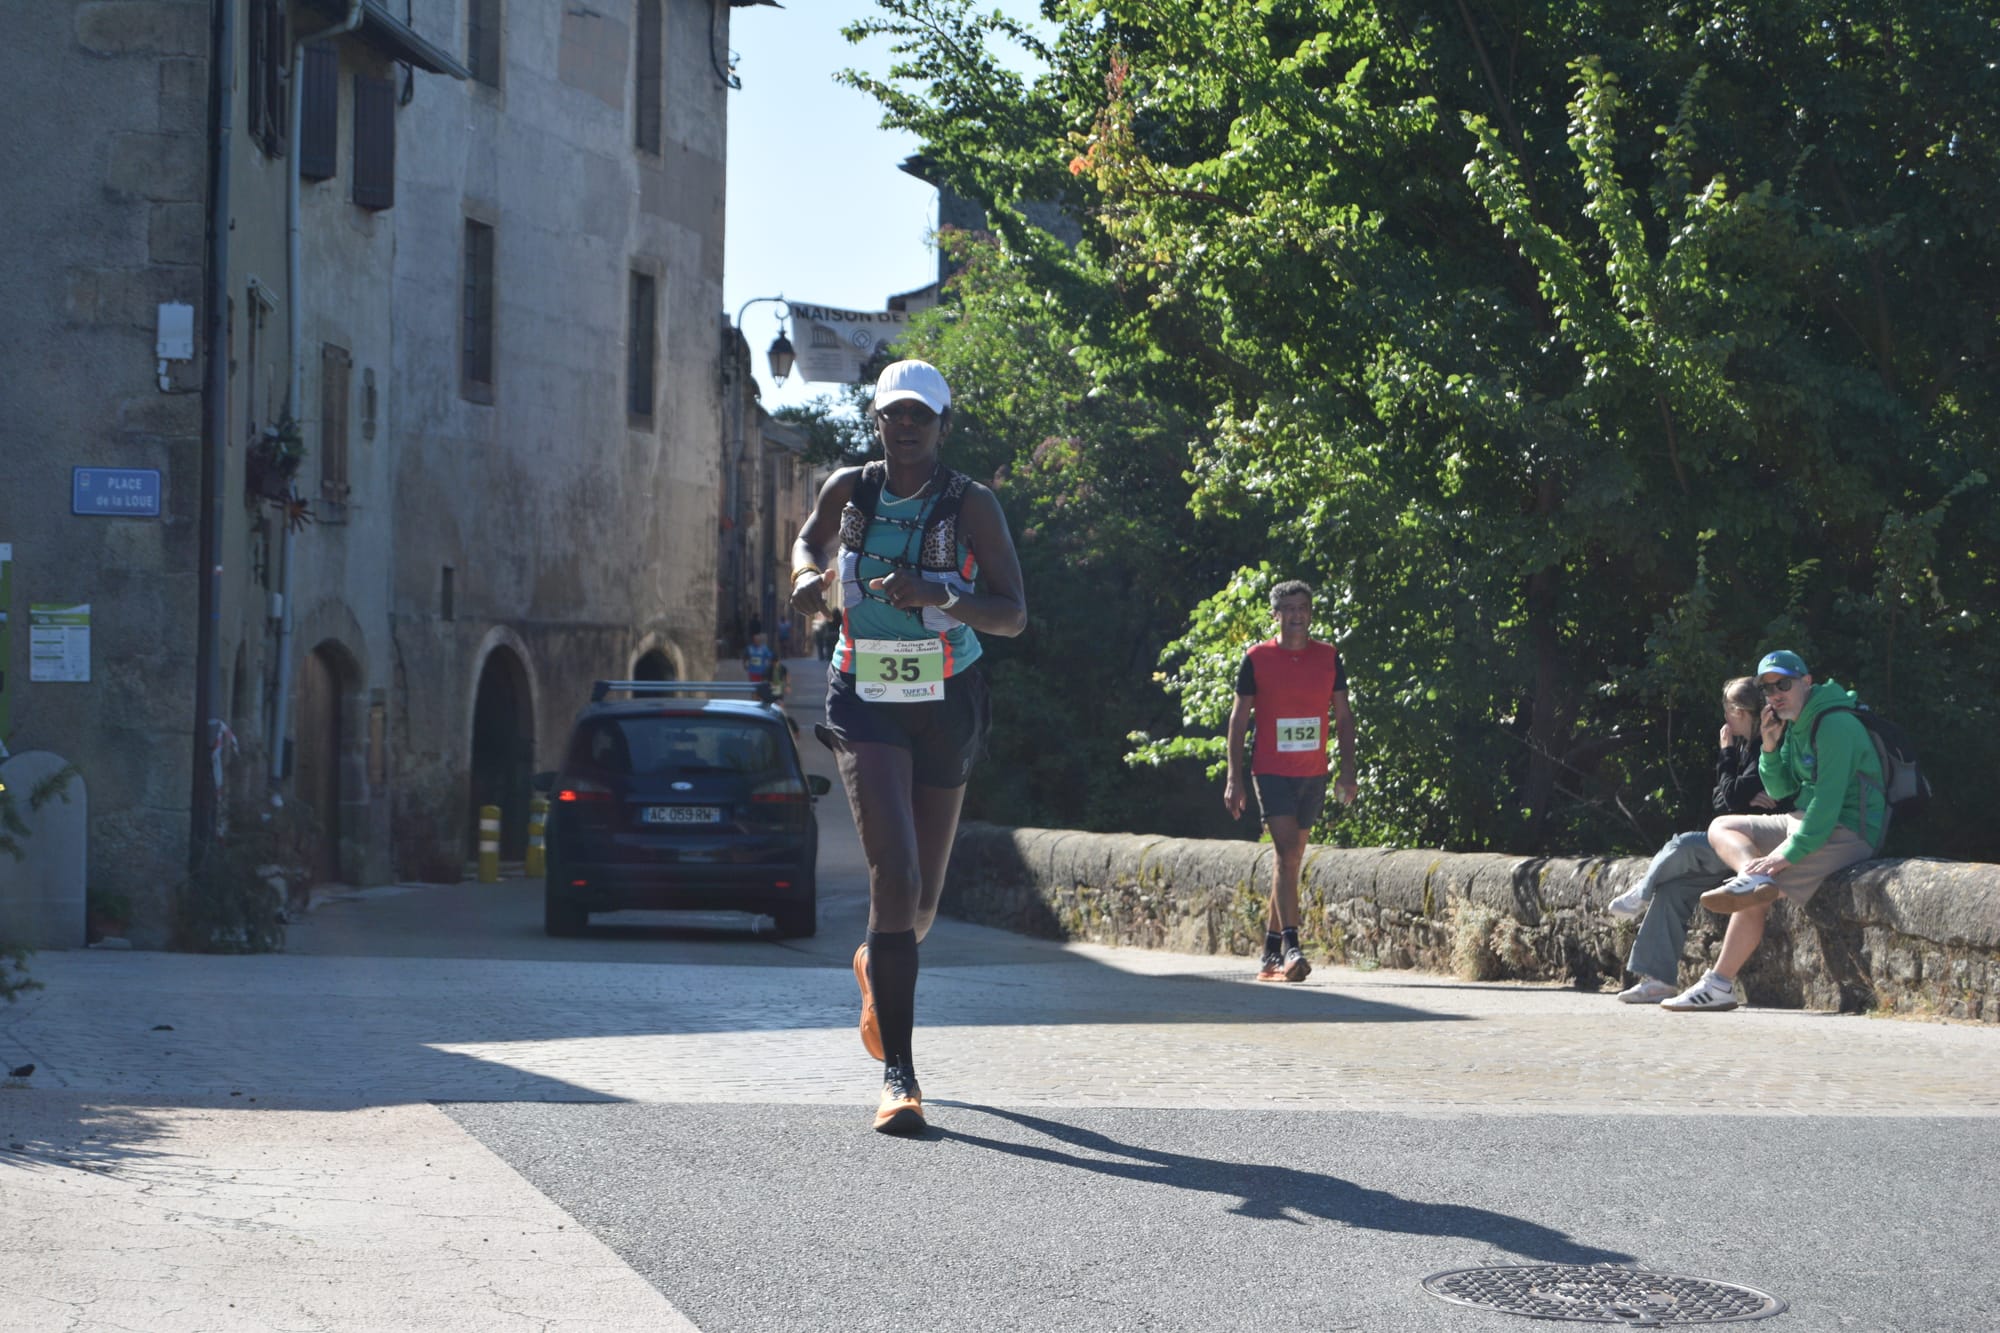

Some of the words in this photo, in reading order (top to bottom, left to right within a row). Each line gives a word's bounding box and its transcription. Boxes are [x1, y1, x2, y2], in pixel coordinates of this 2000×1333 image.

[795, 306, 872, 322] MAISON
[879, 312, 902, 323] DE
[108, 477, 143, 490] PLACE
[125, 496, 154, 508] LOUE
[880, 657, 920, 682] 35
[1284, 727, 1315, 741] 152
